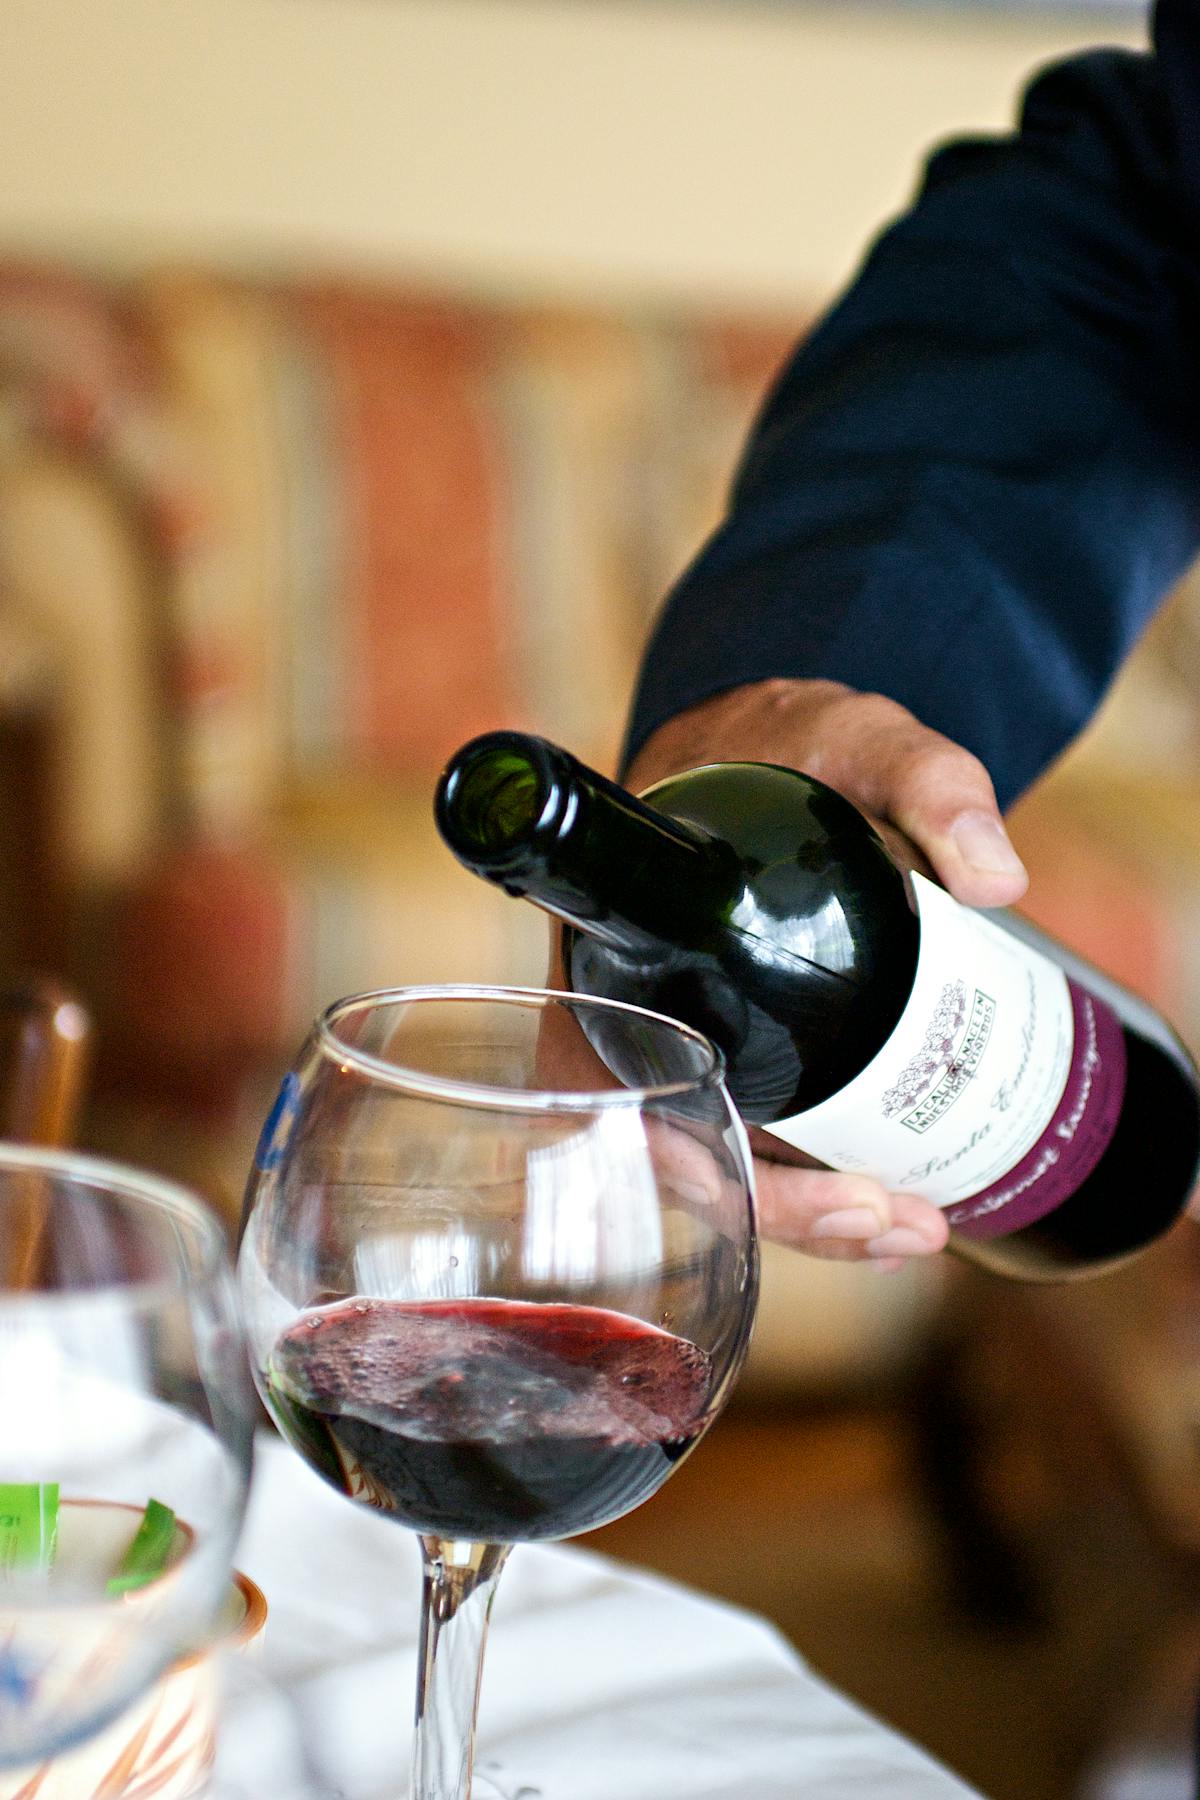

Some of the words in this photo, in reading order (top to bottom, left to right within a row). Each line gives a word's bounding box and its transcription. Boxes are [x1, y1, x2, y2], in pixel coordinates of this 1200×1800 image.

[907, 1111, 926, 1125] LA
[961, 1019, 982, 1055] NACE
[975, 995, 985, 1016] EN
[918, 1066, 971, 1128] NUESTROS
[899, 1122, 993, 1185] Santa
